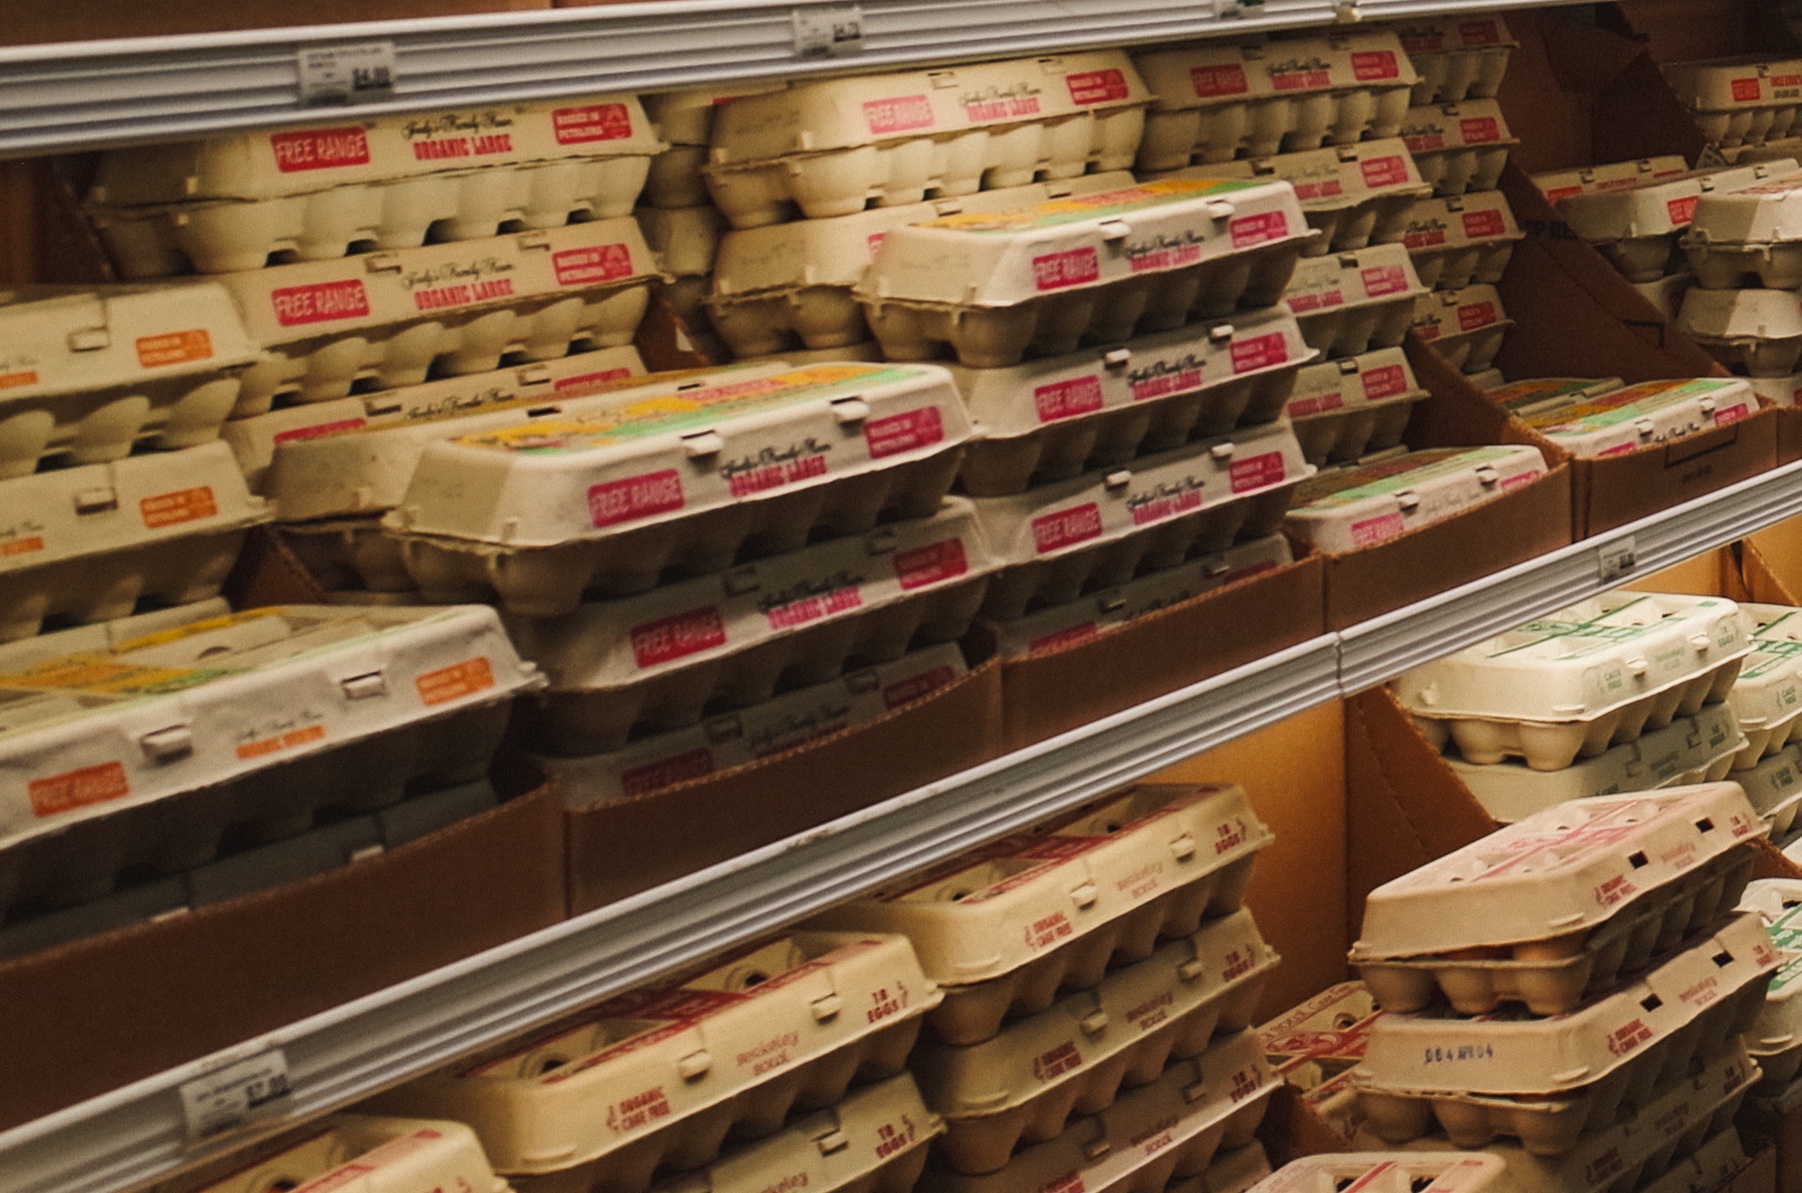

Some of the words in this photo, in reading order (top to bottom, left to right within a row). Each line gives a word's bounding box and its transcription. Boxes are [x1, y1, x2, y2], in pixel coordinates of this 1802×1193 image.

[275, 137, 314, 166] FREE
[315, 133, 368, 159] RANGE
[413, 137, 470, 161] ORGANIC
[471, 133, 514, 156] LARGE
[275, 291, 314, 319] FREE
[315, 286, 368, 314] RANGE
[414, 286, 472, 311] ORGANIC
[472, 277, 514, 302] LARGE
[591, 489, 630, 519] FREE
[631, 478, 684, 507] RANGE
[1214, 832, 1242, 855] EGGS
[1217, 823, 1231, 838] 18
[1033, 910, 1068, 934] ORGANIC
[871, 988, 888, 1006] 18
[866, 999, 899, 1024] EGGS
[618, 1086, 665, 1115] ORGANIC
[877, 1123, 896, 1141] 18
[875, 1133, 908, 1159] EGGS
